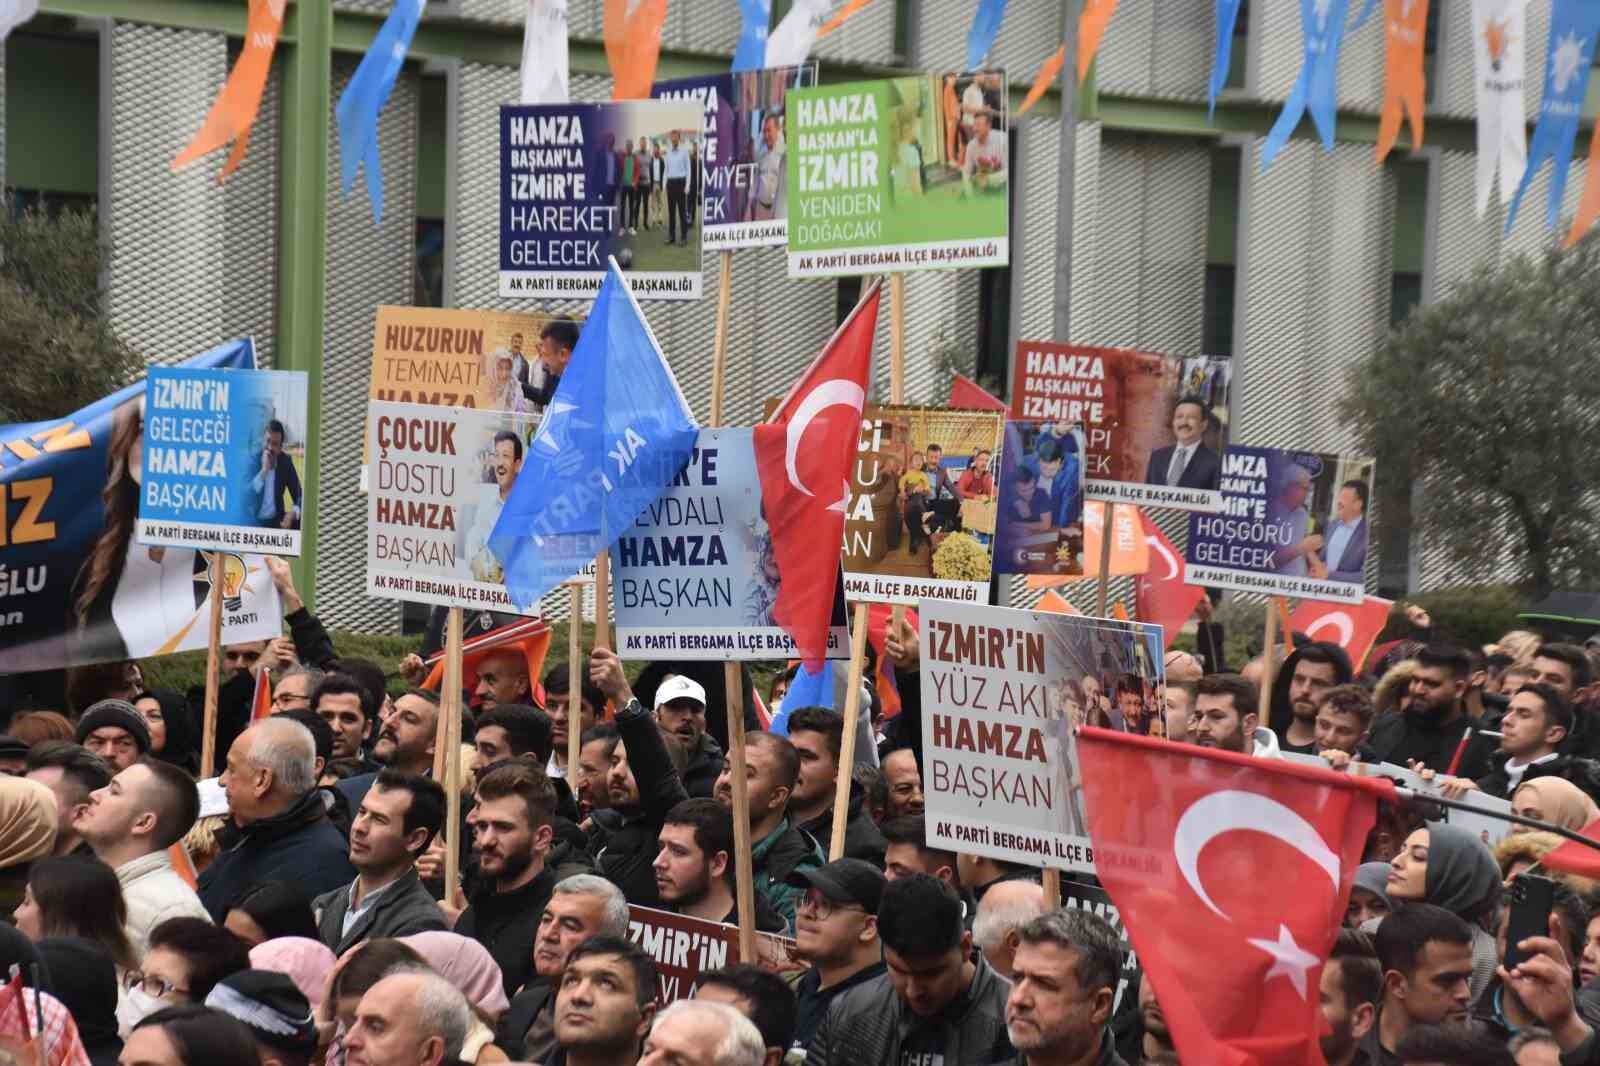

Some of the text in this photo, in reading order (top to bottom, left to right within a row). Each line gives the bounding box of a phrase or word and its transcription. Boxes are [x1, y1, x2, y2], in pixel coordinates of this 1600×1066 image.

[797, 94, 878, 128] HAMZA
[510, 116, 584, 145] HAMZA
[798, 129, 878, 153] BAŞKAN'LA
[511, 149, 583, 172] BAŞKAN'LA
[510, 206, 617, 232] HAREKET
[510, 239, 600, 266] GELECEK
[799, 242, 997, 269] AK PARTİ BERGAMA İLÇE BAŞKANLIĞI
[510, 280, 524, 290] AK
[526, 276, 554, 290] PARTİ
[631, 277, 692, 295] BAŞKANLIĞI
[385, 325, 484, 355] HUZURUN
[1026, 351, 1104, 380] HAMZA
[1025, 379, 1103, 399] BAŞKAN'LA
[378, 415, 456, 459] ÇOCUK
[148, 447, 226, 478] HAMZA
[379, 460, 455, 497] DOSTU
[147, 481, 226, 515] BAŞKAN
[376, 498, 456, 531] HAMZA
[145, 525, 293, 548] AK PARTİ BERGAMA İLÇE BAŞKANLIĞI
[1197, 517, 1294, 545] HOŞGÖRÜ
[376, 534, 456, 569] BAŞKAN
[620, 535, 728, 567] HAMZA
[1195, 543, 1276, 569] GELECEK
[375, 575, 386, 588] AK
[389, 576, 413, 591] PARTİ
[416, 581, 456, 598] BERGAMA
[459, 583, 477, 602] İLÇE
[874, 579, 900, 600] İLÇE
[1193, 570, 1206, 580] AK
[1235, 575, 1276, 588] BERGAMA
[623, 578, 732, 616] BAŞKAN
[627, 636, 642, 649] AK
[645, 632, 676, 649] PARTİ
[680, 635, 734, 649] BERGAMA
[738, 632, 763, 653] İLÇE
[931, 667, 1048, 719] YÜZ AKI
[933, 714, 1048, 764] HAMZA
[933, 759, 1052, 809] BAŞKAN
[936, 822, 952, 839] AK
[956, 825, 990, 846] PARTİ
[993, 831, 1051, 857] BERGAMA
[1055, 838, 1083, 865] İLÇE
